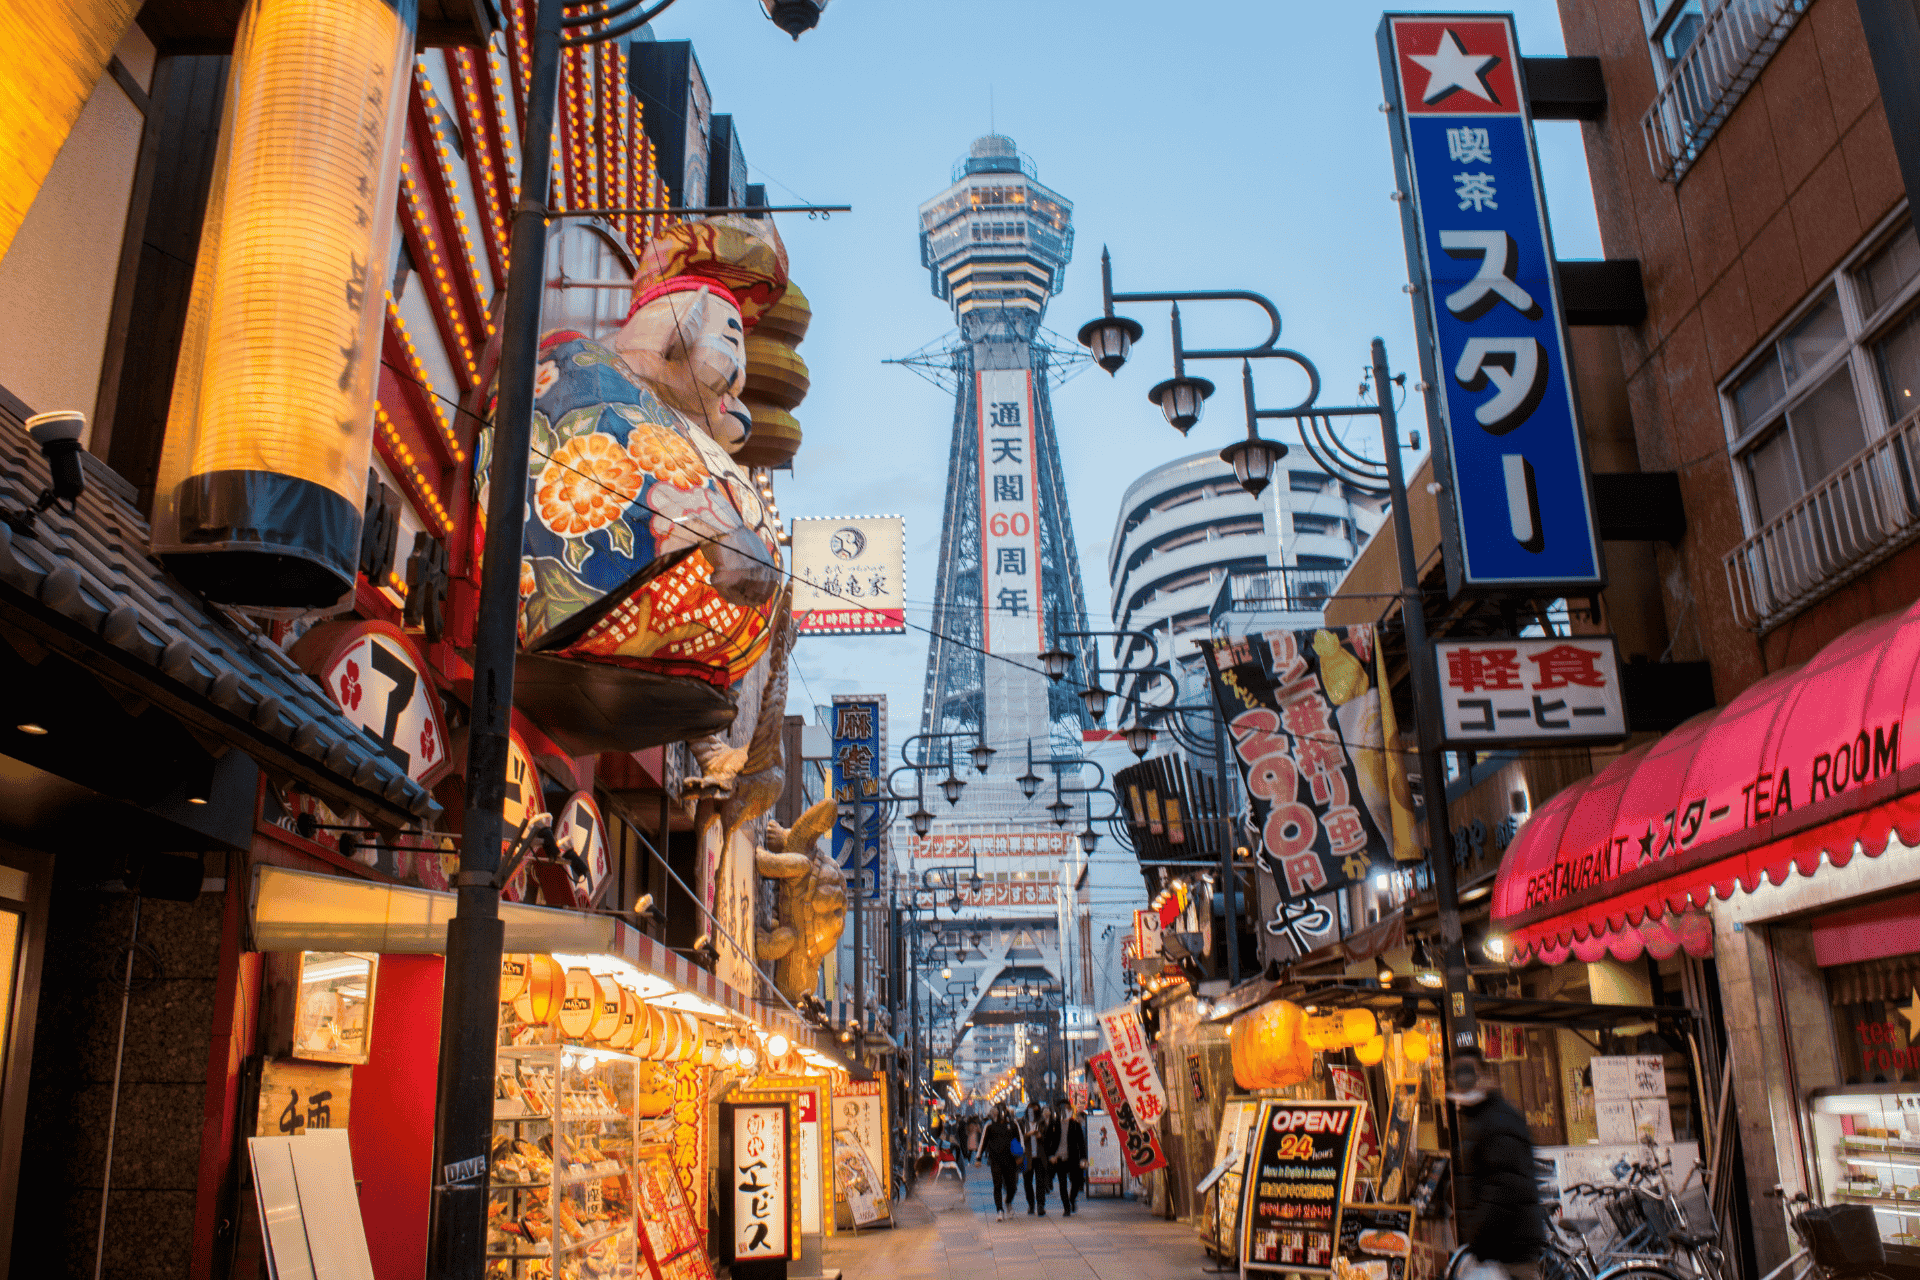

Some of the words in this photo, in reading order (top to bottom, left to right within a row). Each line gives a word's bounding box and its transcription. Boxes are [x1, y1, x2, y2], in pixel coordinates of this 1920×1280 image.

[1446, 126, 1499, 212] 喫茶
[1438, 229, 1540, 544] スター
[989, 401, 1031, 617] 通天閣60周年
[1446, 645, 1606, 693] 軽食
[834, 704, 875, 780] 麻雀
[1457, 695, 1606, 732] コーヒー
[834, 777, 879, 804] NW
[1228, 706, 1329, 897] 290円
[1525, 837, 1629, 911] RESTAURANT
[1659, 798, 1731, 857] スター
[1742, 766, 1793, 830] TEA
[1810, 722, 1900, 803] ROOM
[1856, 1019, 1898, 1046] tea
[1121, 1055, 1162, 1121] どて焼
[1272, 1110, 1350, 1134] OPEN!
[1277, 1133, 1314, 1161] 24
[445, 1154, 486, 1183] DAVE
